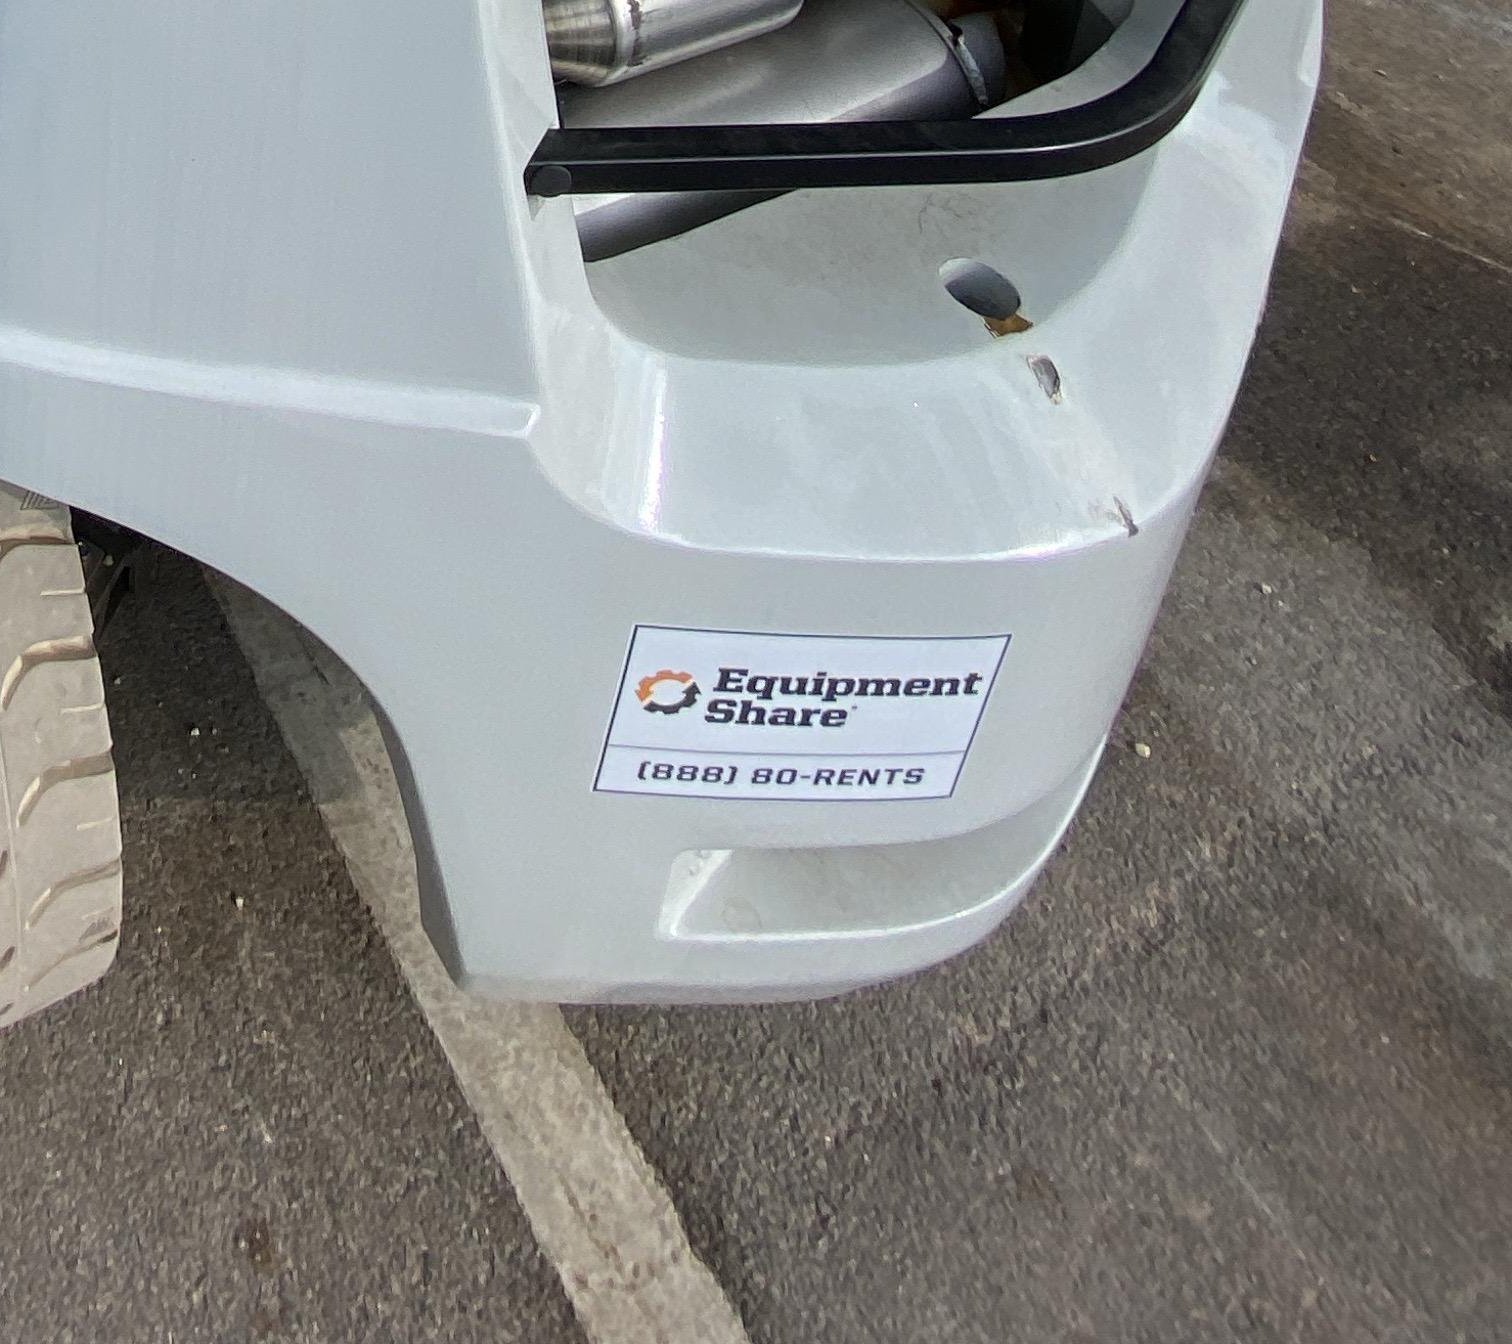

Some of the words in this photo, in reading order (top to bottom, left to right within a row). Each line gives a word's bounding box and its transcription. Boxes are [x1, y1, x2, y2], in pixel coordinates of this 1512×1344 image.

[712, 667, 983, 702] Equipment
[704, 698, 849, 728] Share
[637, 760, 739, 786] (888)
[751, 767, 927, 787] 80-RENTS
